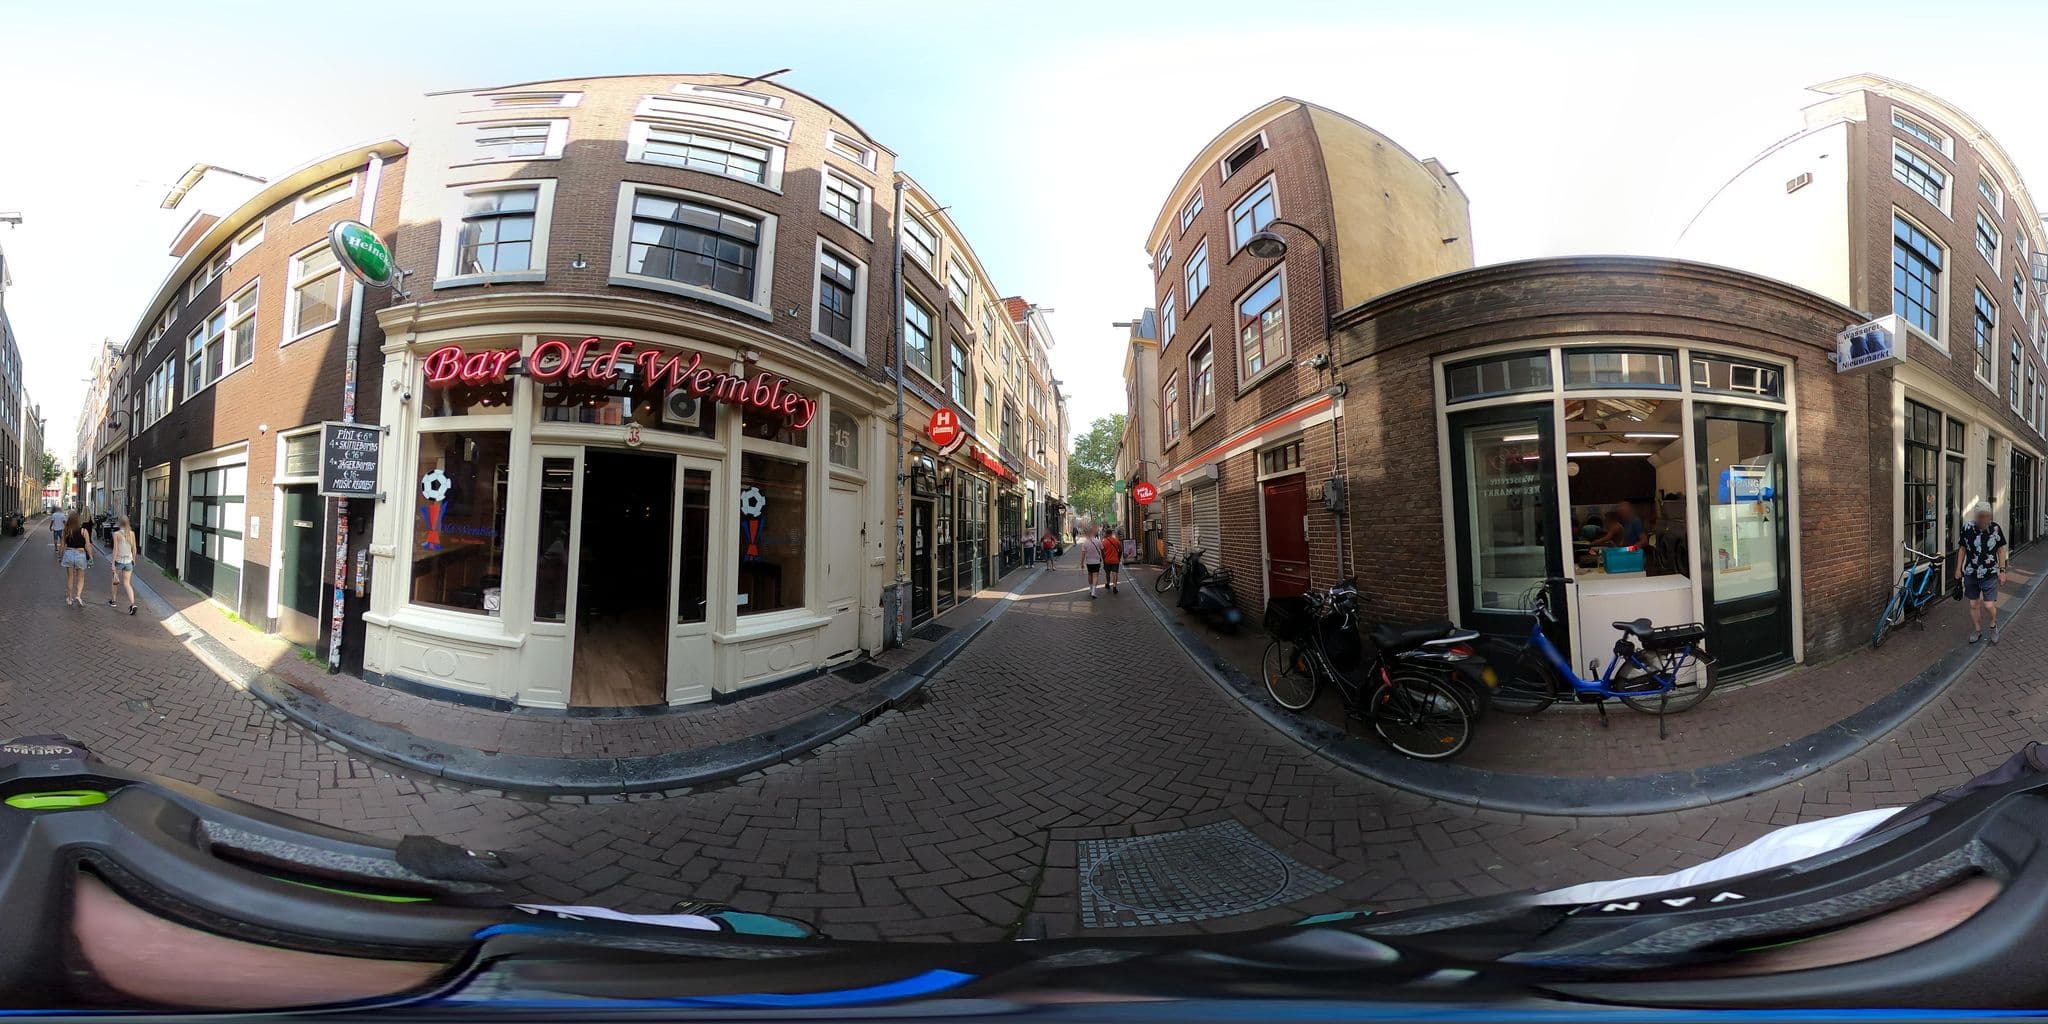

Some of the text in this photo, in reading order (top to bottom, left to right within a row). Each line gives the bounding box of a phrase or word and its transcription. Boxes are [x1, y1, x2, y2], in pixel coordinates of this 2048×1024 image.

[1841, 350, 1889, 369] Nieuwmarkt
[423, 337, 817, 430] Bar Old Wembley
[628, 429, 641, 443] 15
[834, 428, 851, 448] 15
